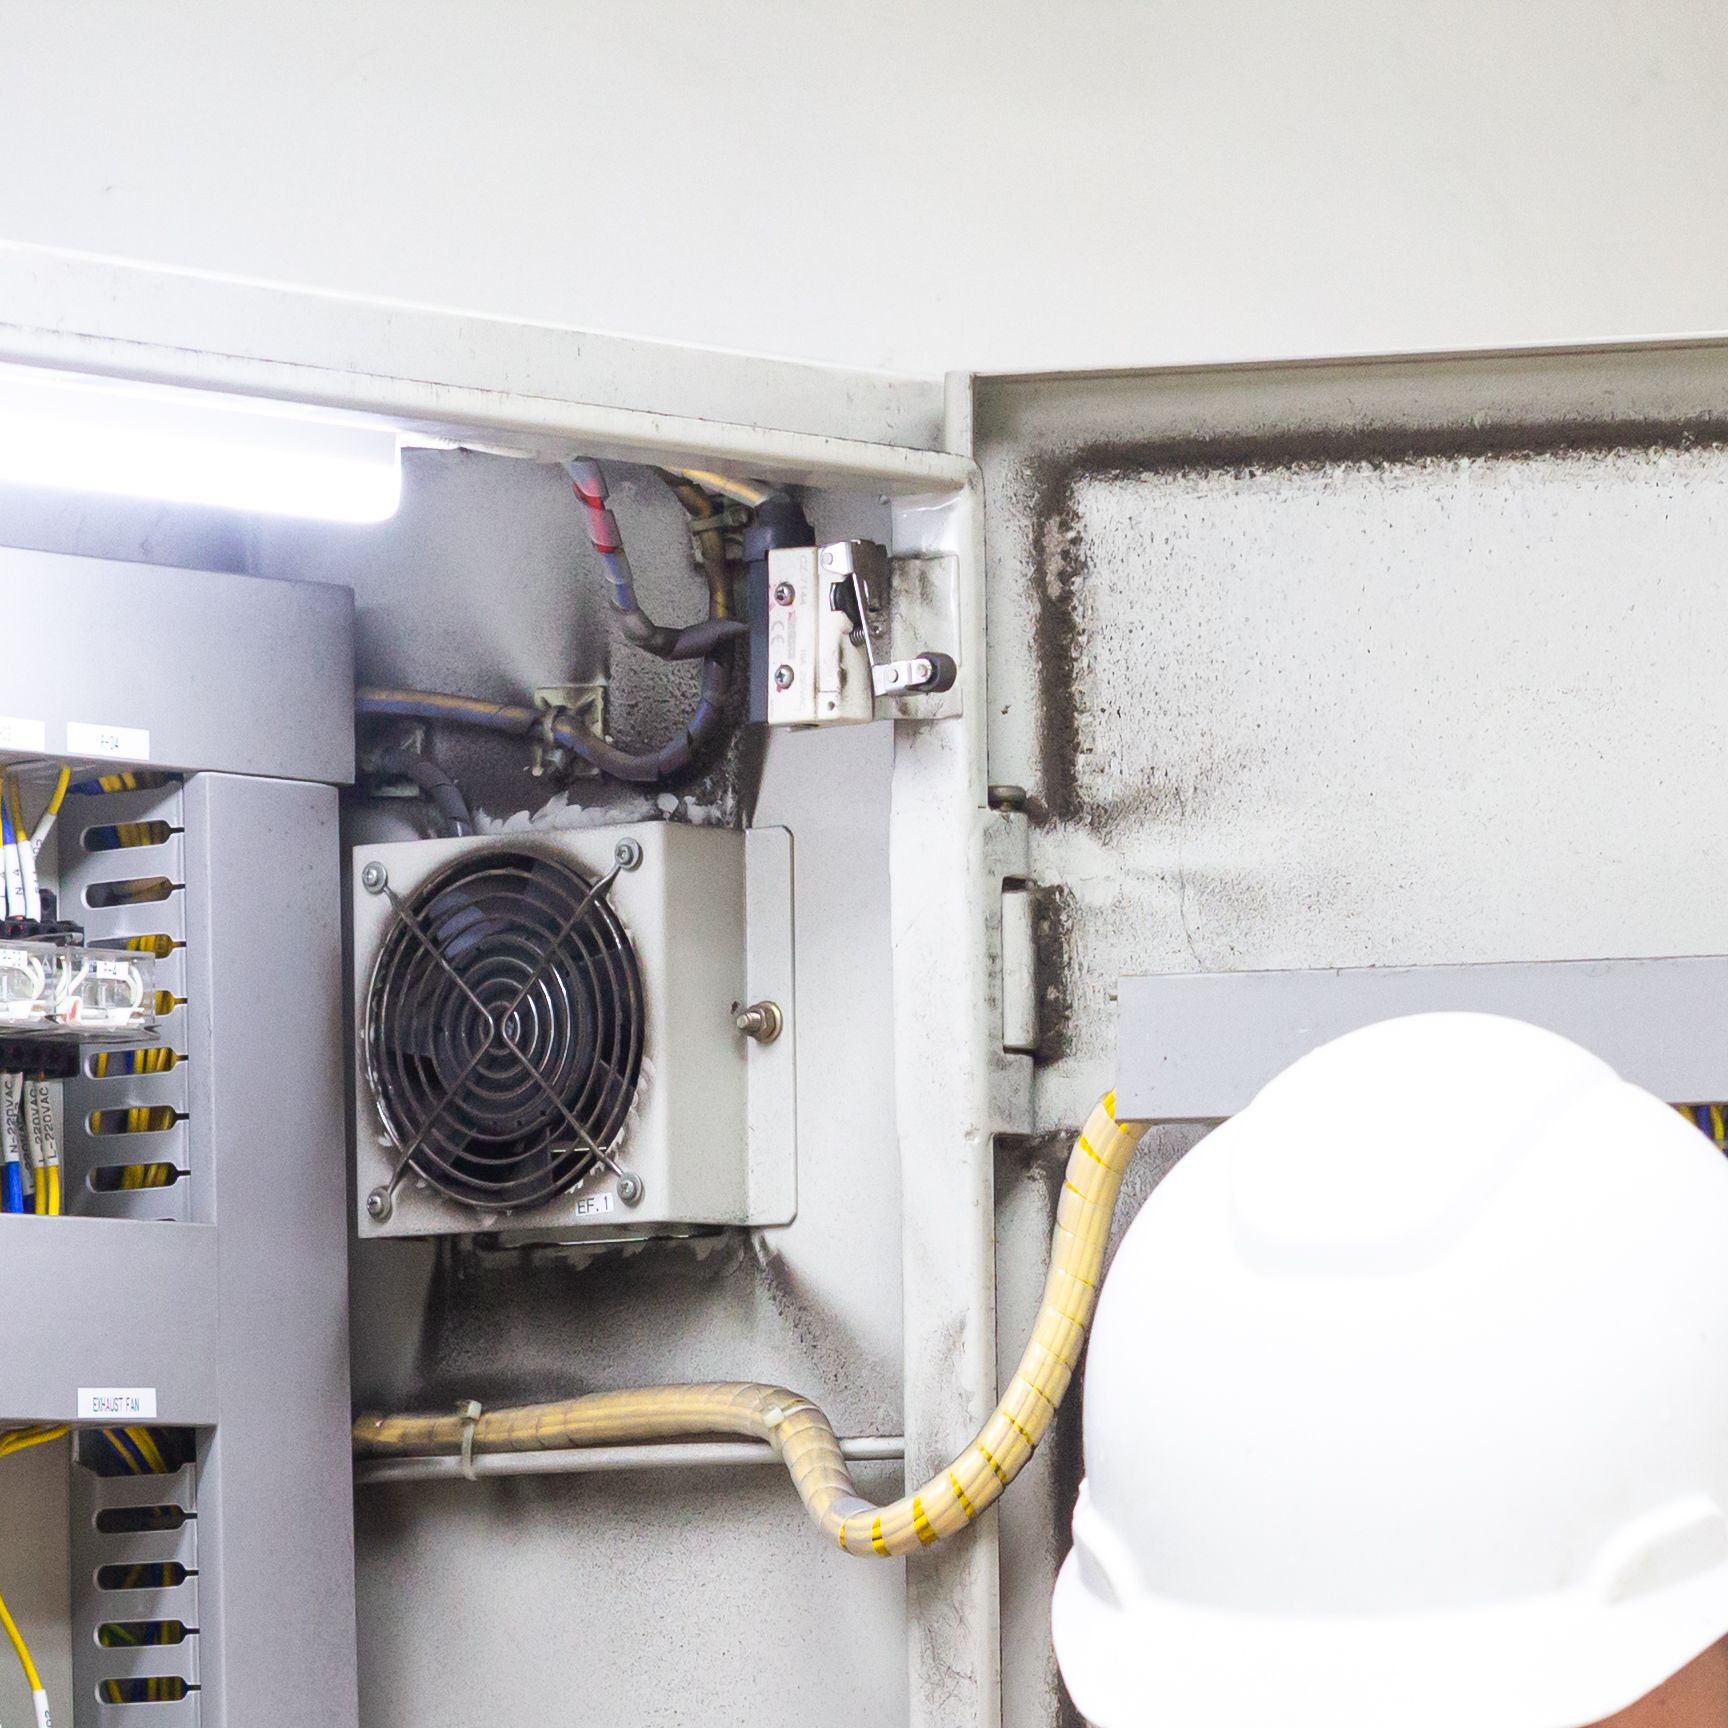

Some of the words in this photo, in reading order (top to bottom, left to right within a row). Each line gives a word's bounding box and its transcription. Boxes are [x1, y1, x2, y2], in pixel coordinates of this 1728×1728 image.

[12, 868, 20, 877] 4
[15, 887, 23, 896] N
[44, 1086, 57, 1160] L-220VAC
[92, 1397, 123, 1413] EXHAUST
[125, 1397, 140, 1413] FAN
